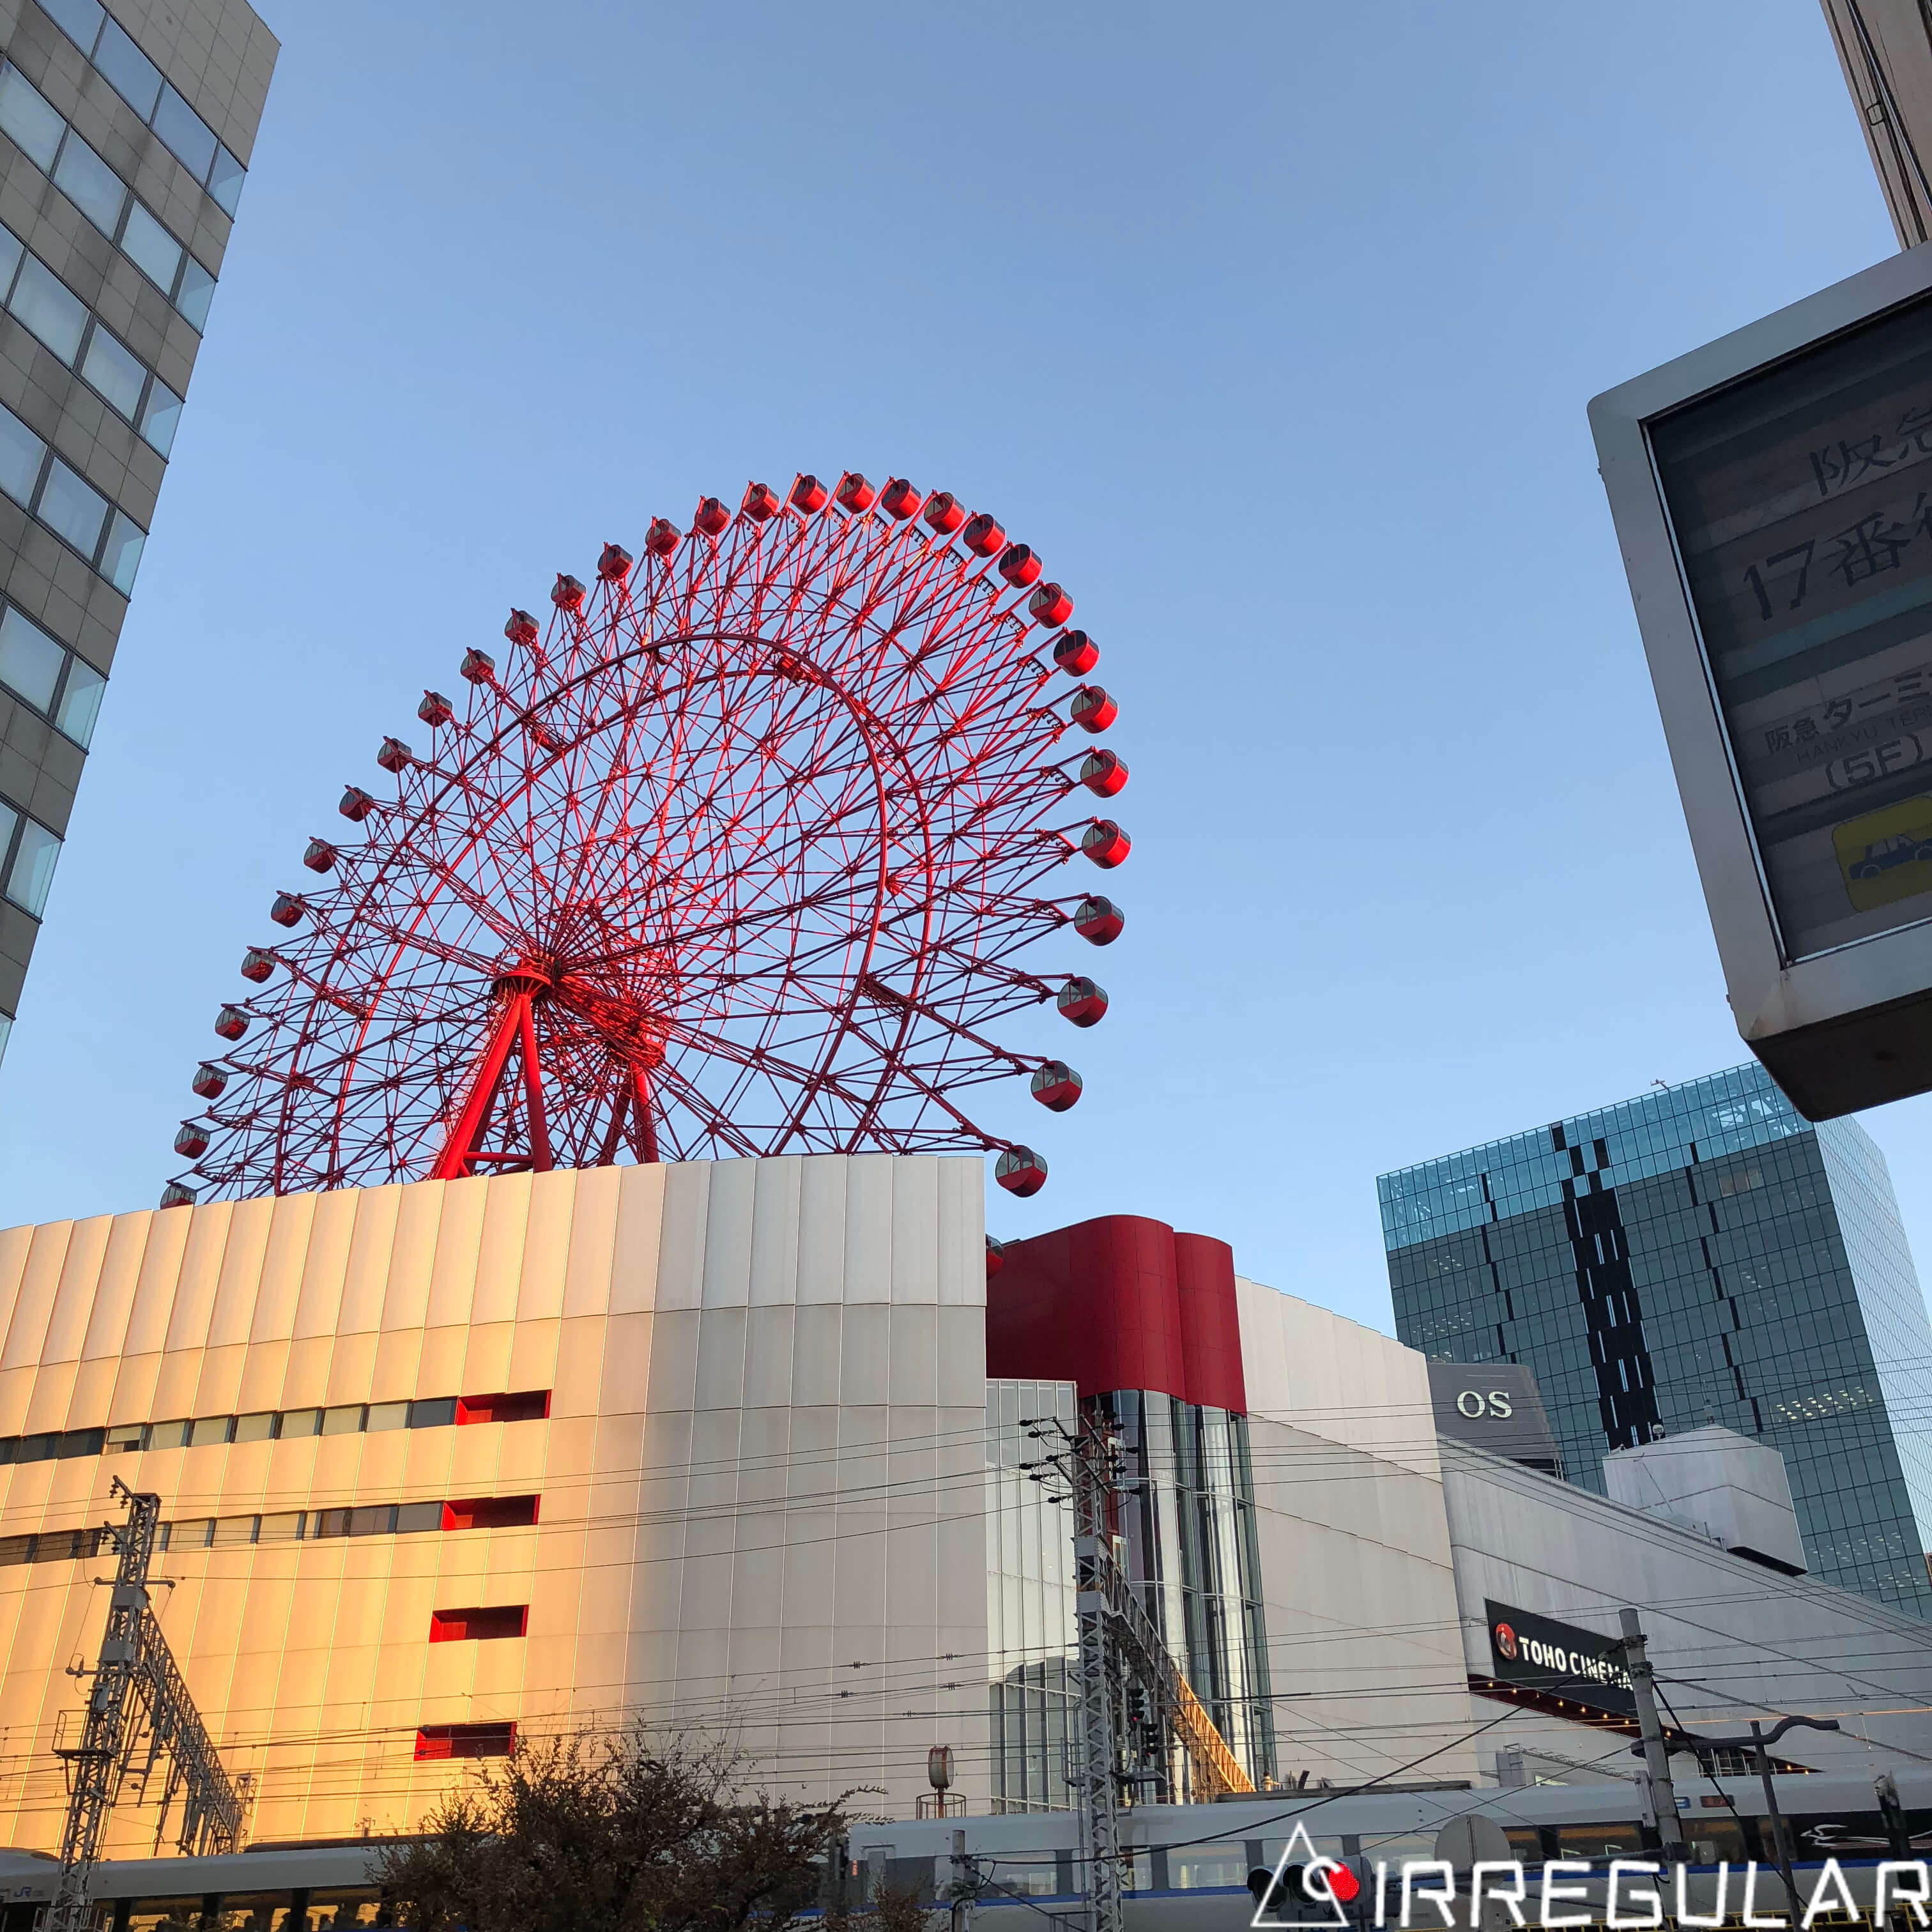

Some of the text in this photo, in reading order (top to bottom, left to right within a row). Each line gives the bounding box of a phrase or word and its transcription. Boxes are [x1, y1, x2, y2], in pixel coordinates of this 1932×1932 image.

[1743, 491, 1932, 621] 17番
[1765, 671, 1932, 754] 阪急ターミ
[1797, 723, 1877, 763] HANKYU
[1825, 733, 1924, 790] (5F)
[1457, 1390, 1513, 1418] OS
[1518, 1636, 1634, 1691] TOHO CINEMA
